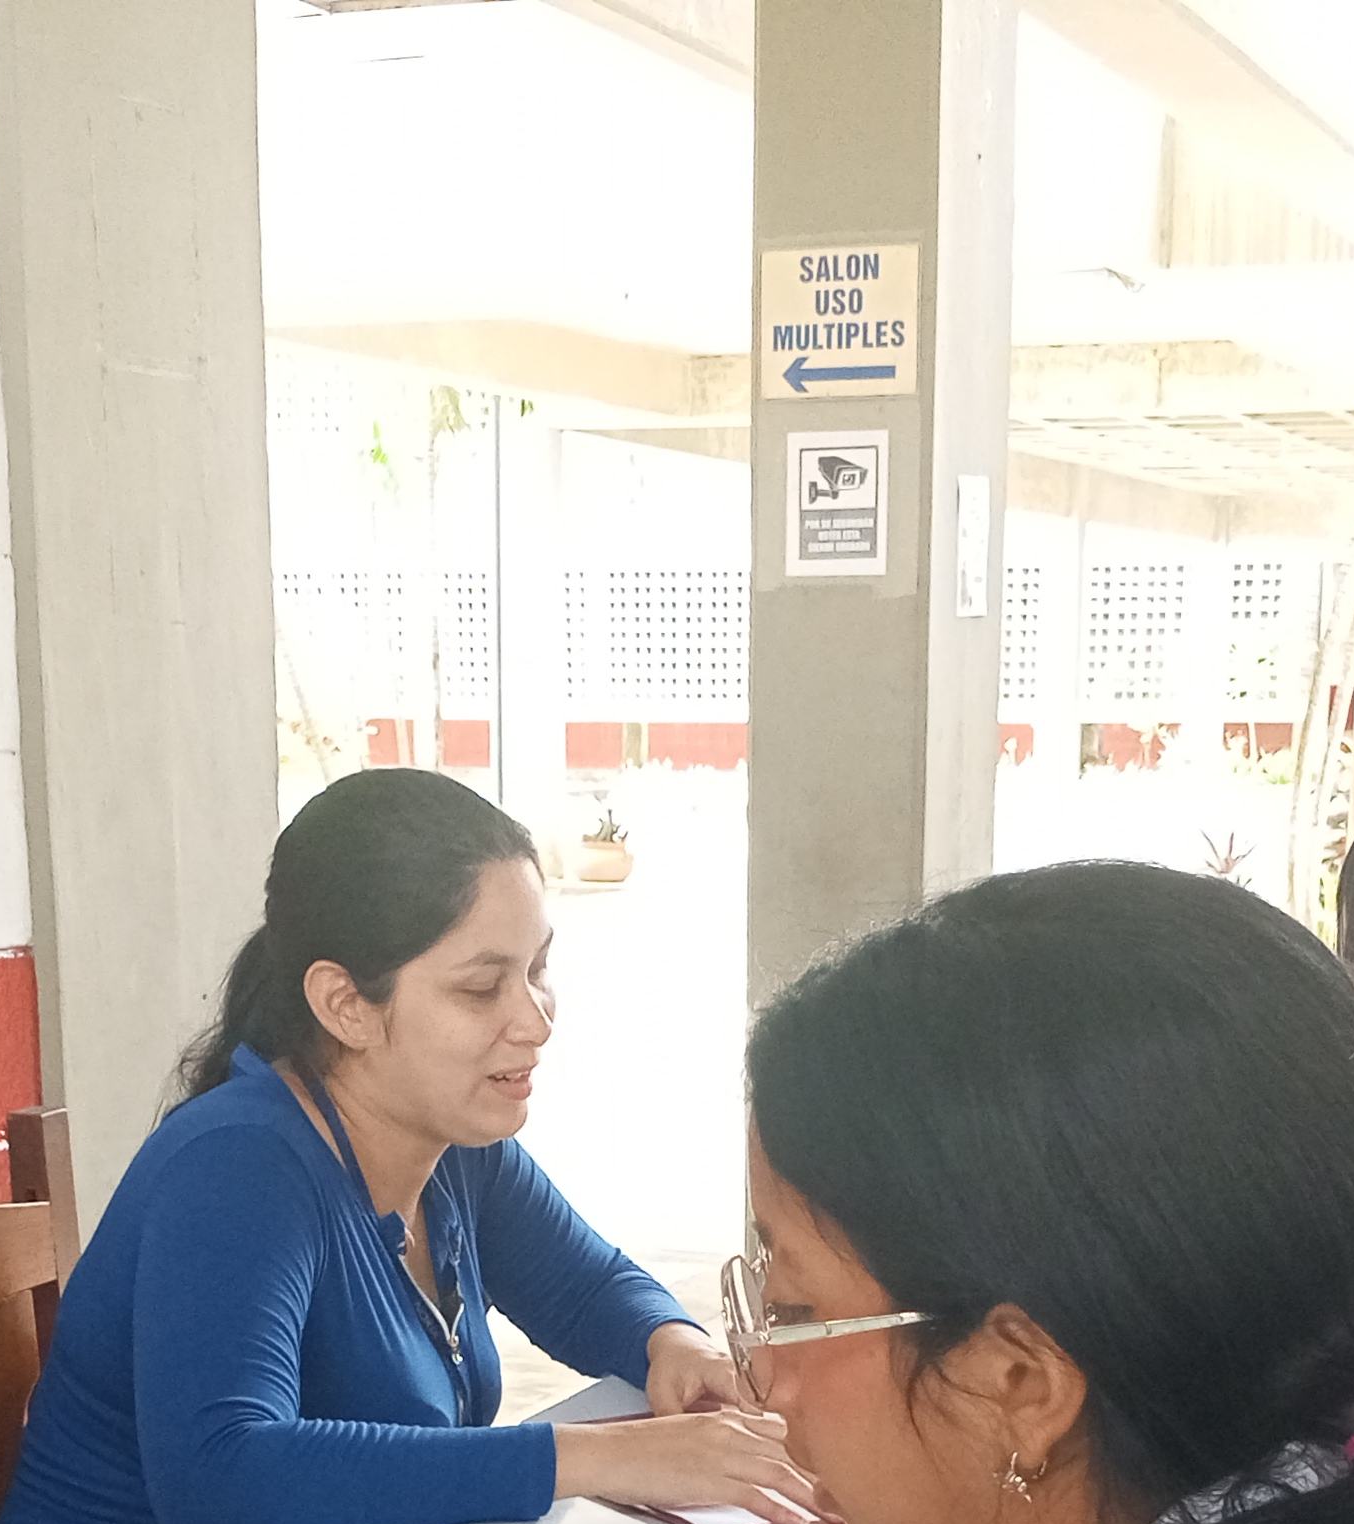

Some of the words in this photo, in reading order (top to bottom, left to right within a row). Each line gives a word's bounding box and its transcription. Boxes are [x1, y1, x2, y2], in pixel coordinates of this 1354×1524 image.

[799, 253, 880, 283] SALON
[815, 288, 864, 316] USO
[773, 320, 905, 352] MULTIPLES
